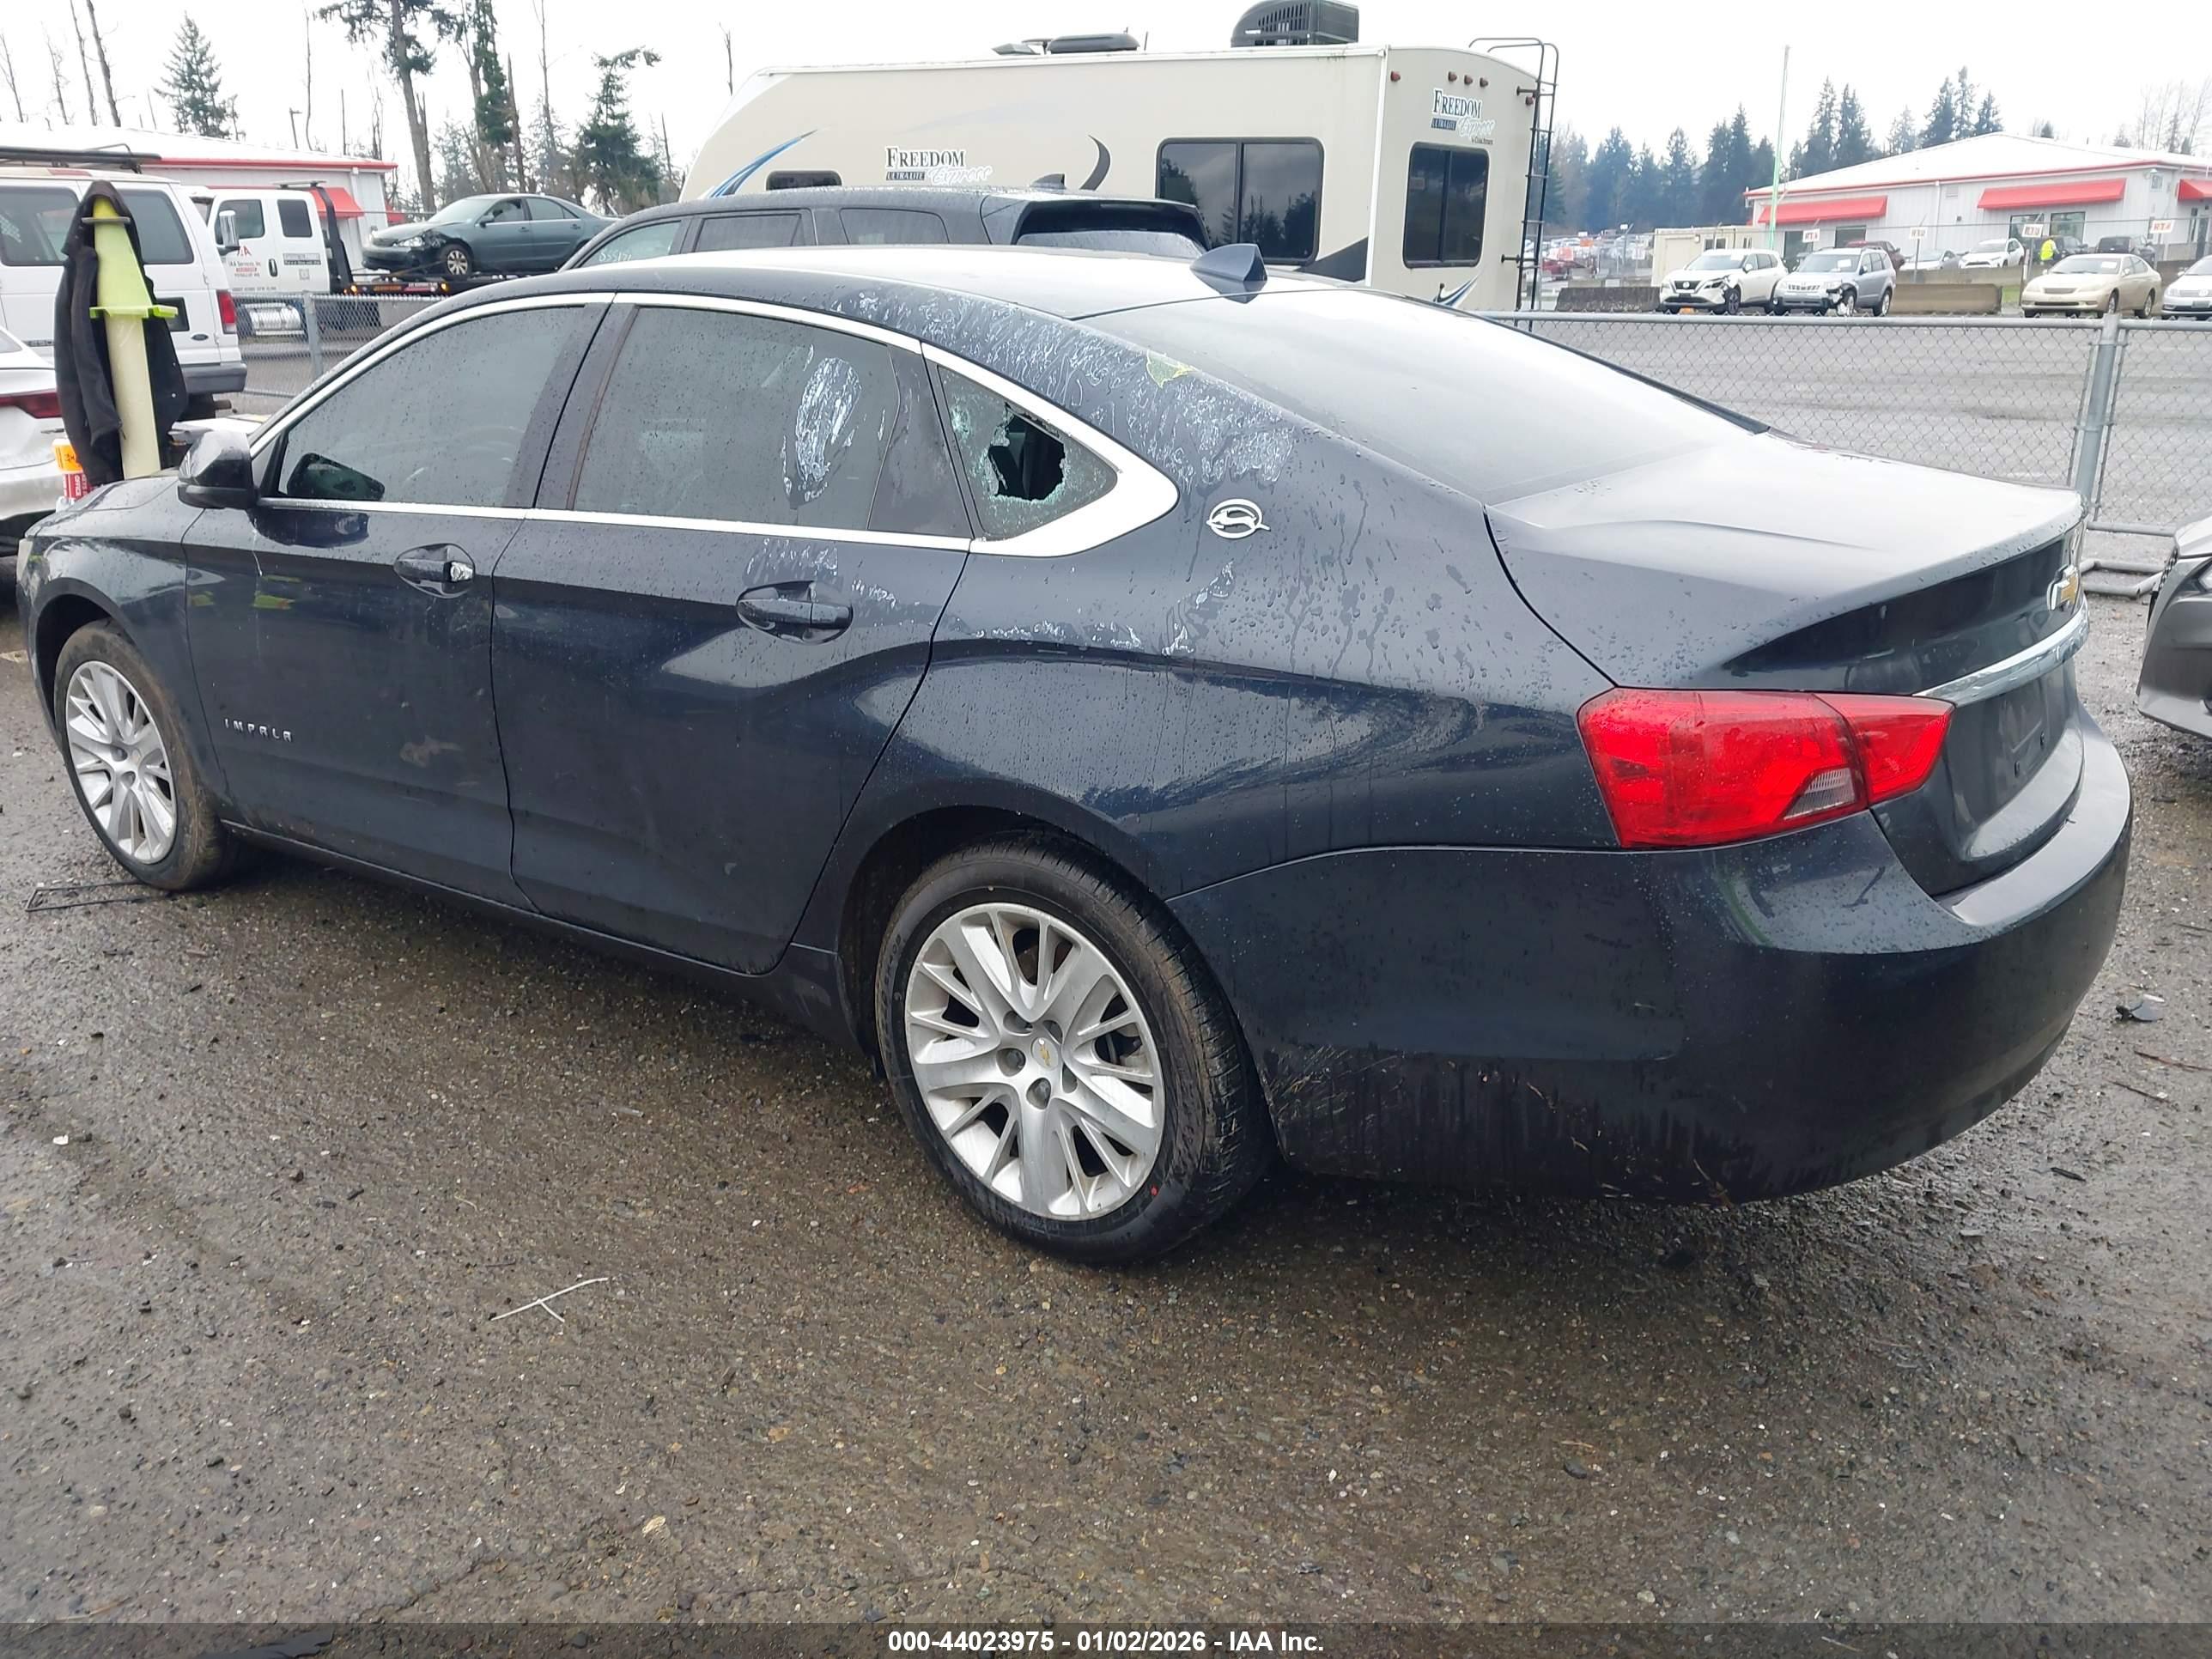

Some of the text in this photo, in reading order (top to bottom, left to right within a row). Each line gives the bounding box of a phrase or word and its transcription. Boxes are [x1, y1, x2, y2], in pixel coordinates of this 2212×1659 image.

[1433, 89, 1481, 118] FREEDOM
[886, 147, 965, 167] FREEDOM
[224, 718, 292, 743] IMPALA
